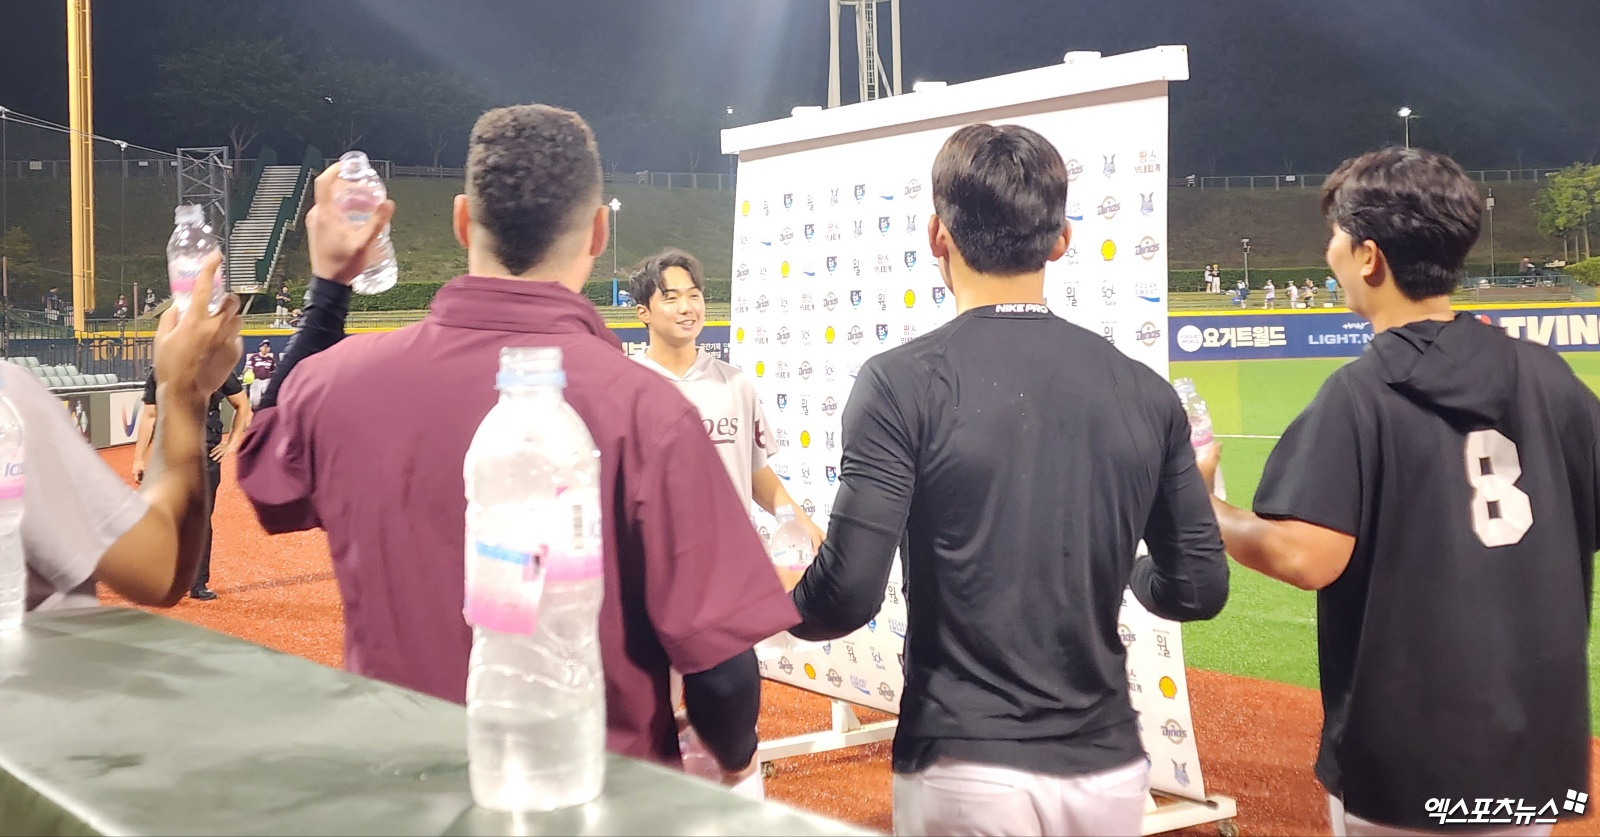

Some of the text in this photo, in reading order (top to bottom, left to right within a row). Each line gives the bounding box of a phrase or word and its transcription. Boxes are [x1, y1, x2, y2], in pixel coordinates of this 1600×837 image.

[995, 304, 1049, 314] NIKE PRO
[1203, 326, 1287, 348] 요거트월드
[1500, 314, 1600, 346] TVIN
[1465, 428, 1535, 548] 8
